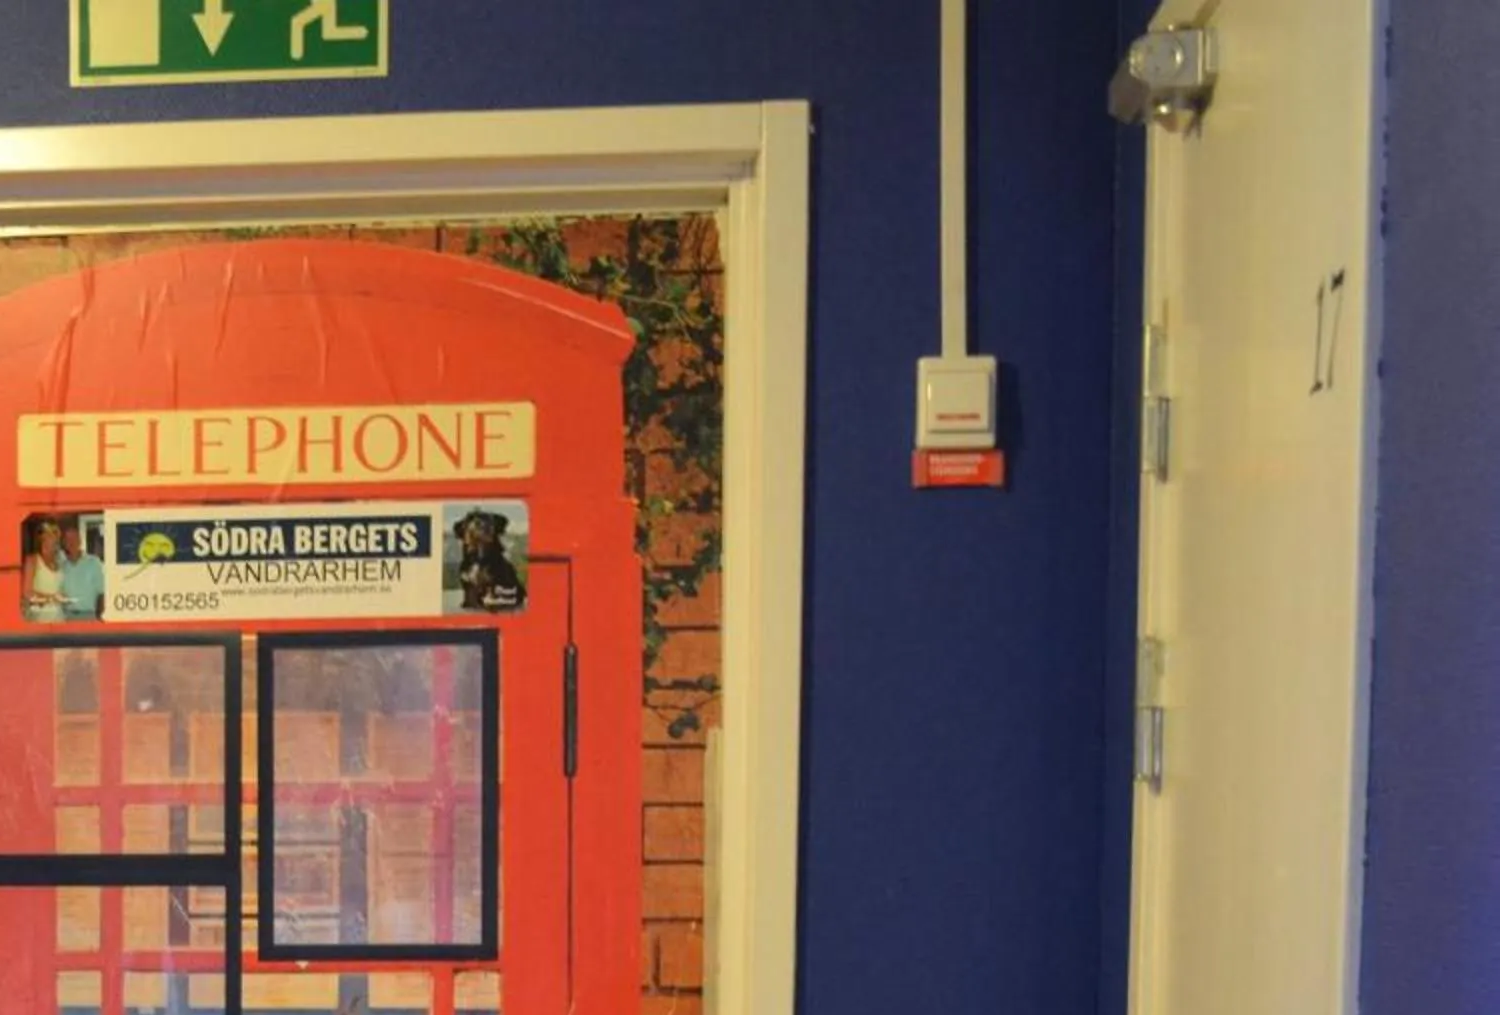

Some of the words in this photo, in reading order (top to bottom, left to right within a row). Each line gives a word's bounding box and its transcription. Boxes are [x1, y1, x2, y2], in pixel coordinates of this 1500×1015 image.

[38, 410, 515, 479] TELEPHONE
[192, 520, 286, 557] SÖDRA
[294, 521, 418, 555] BERGETS
[206, 559, 402, 585] VANDRARHEM
[113, 592, 220, 612] 060152565
